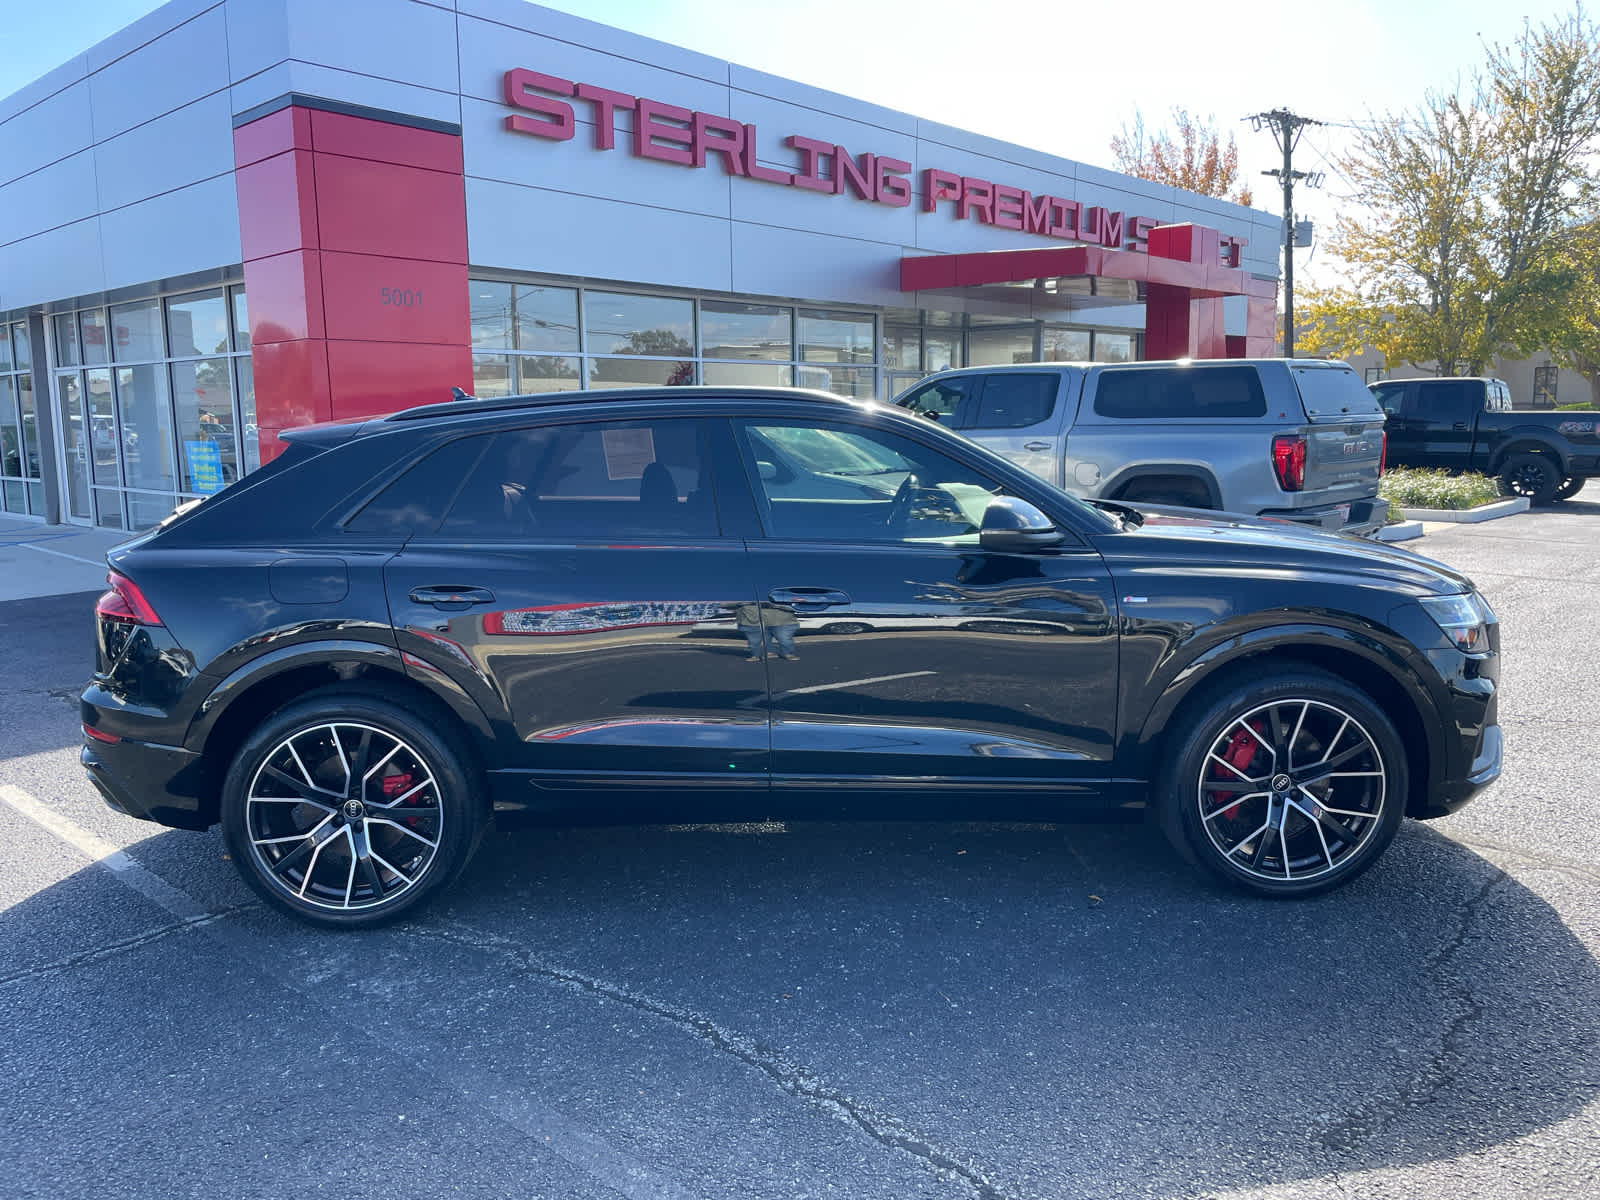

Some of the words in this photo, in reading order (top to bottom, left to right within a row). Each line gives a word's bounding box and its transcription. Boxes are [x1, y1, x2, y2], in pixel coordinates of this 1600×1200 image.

[503, 68, 912, 207] STERLING
[922, 168, 1125, 249] PREMIUM
[381, 287, 423, 308] 5001
